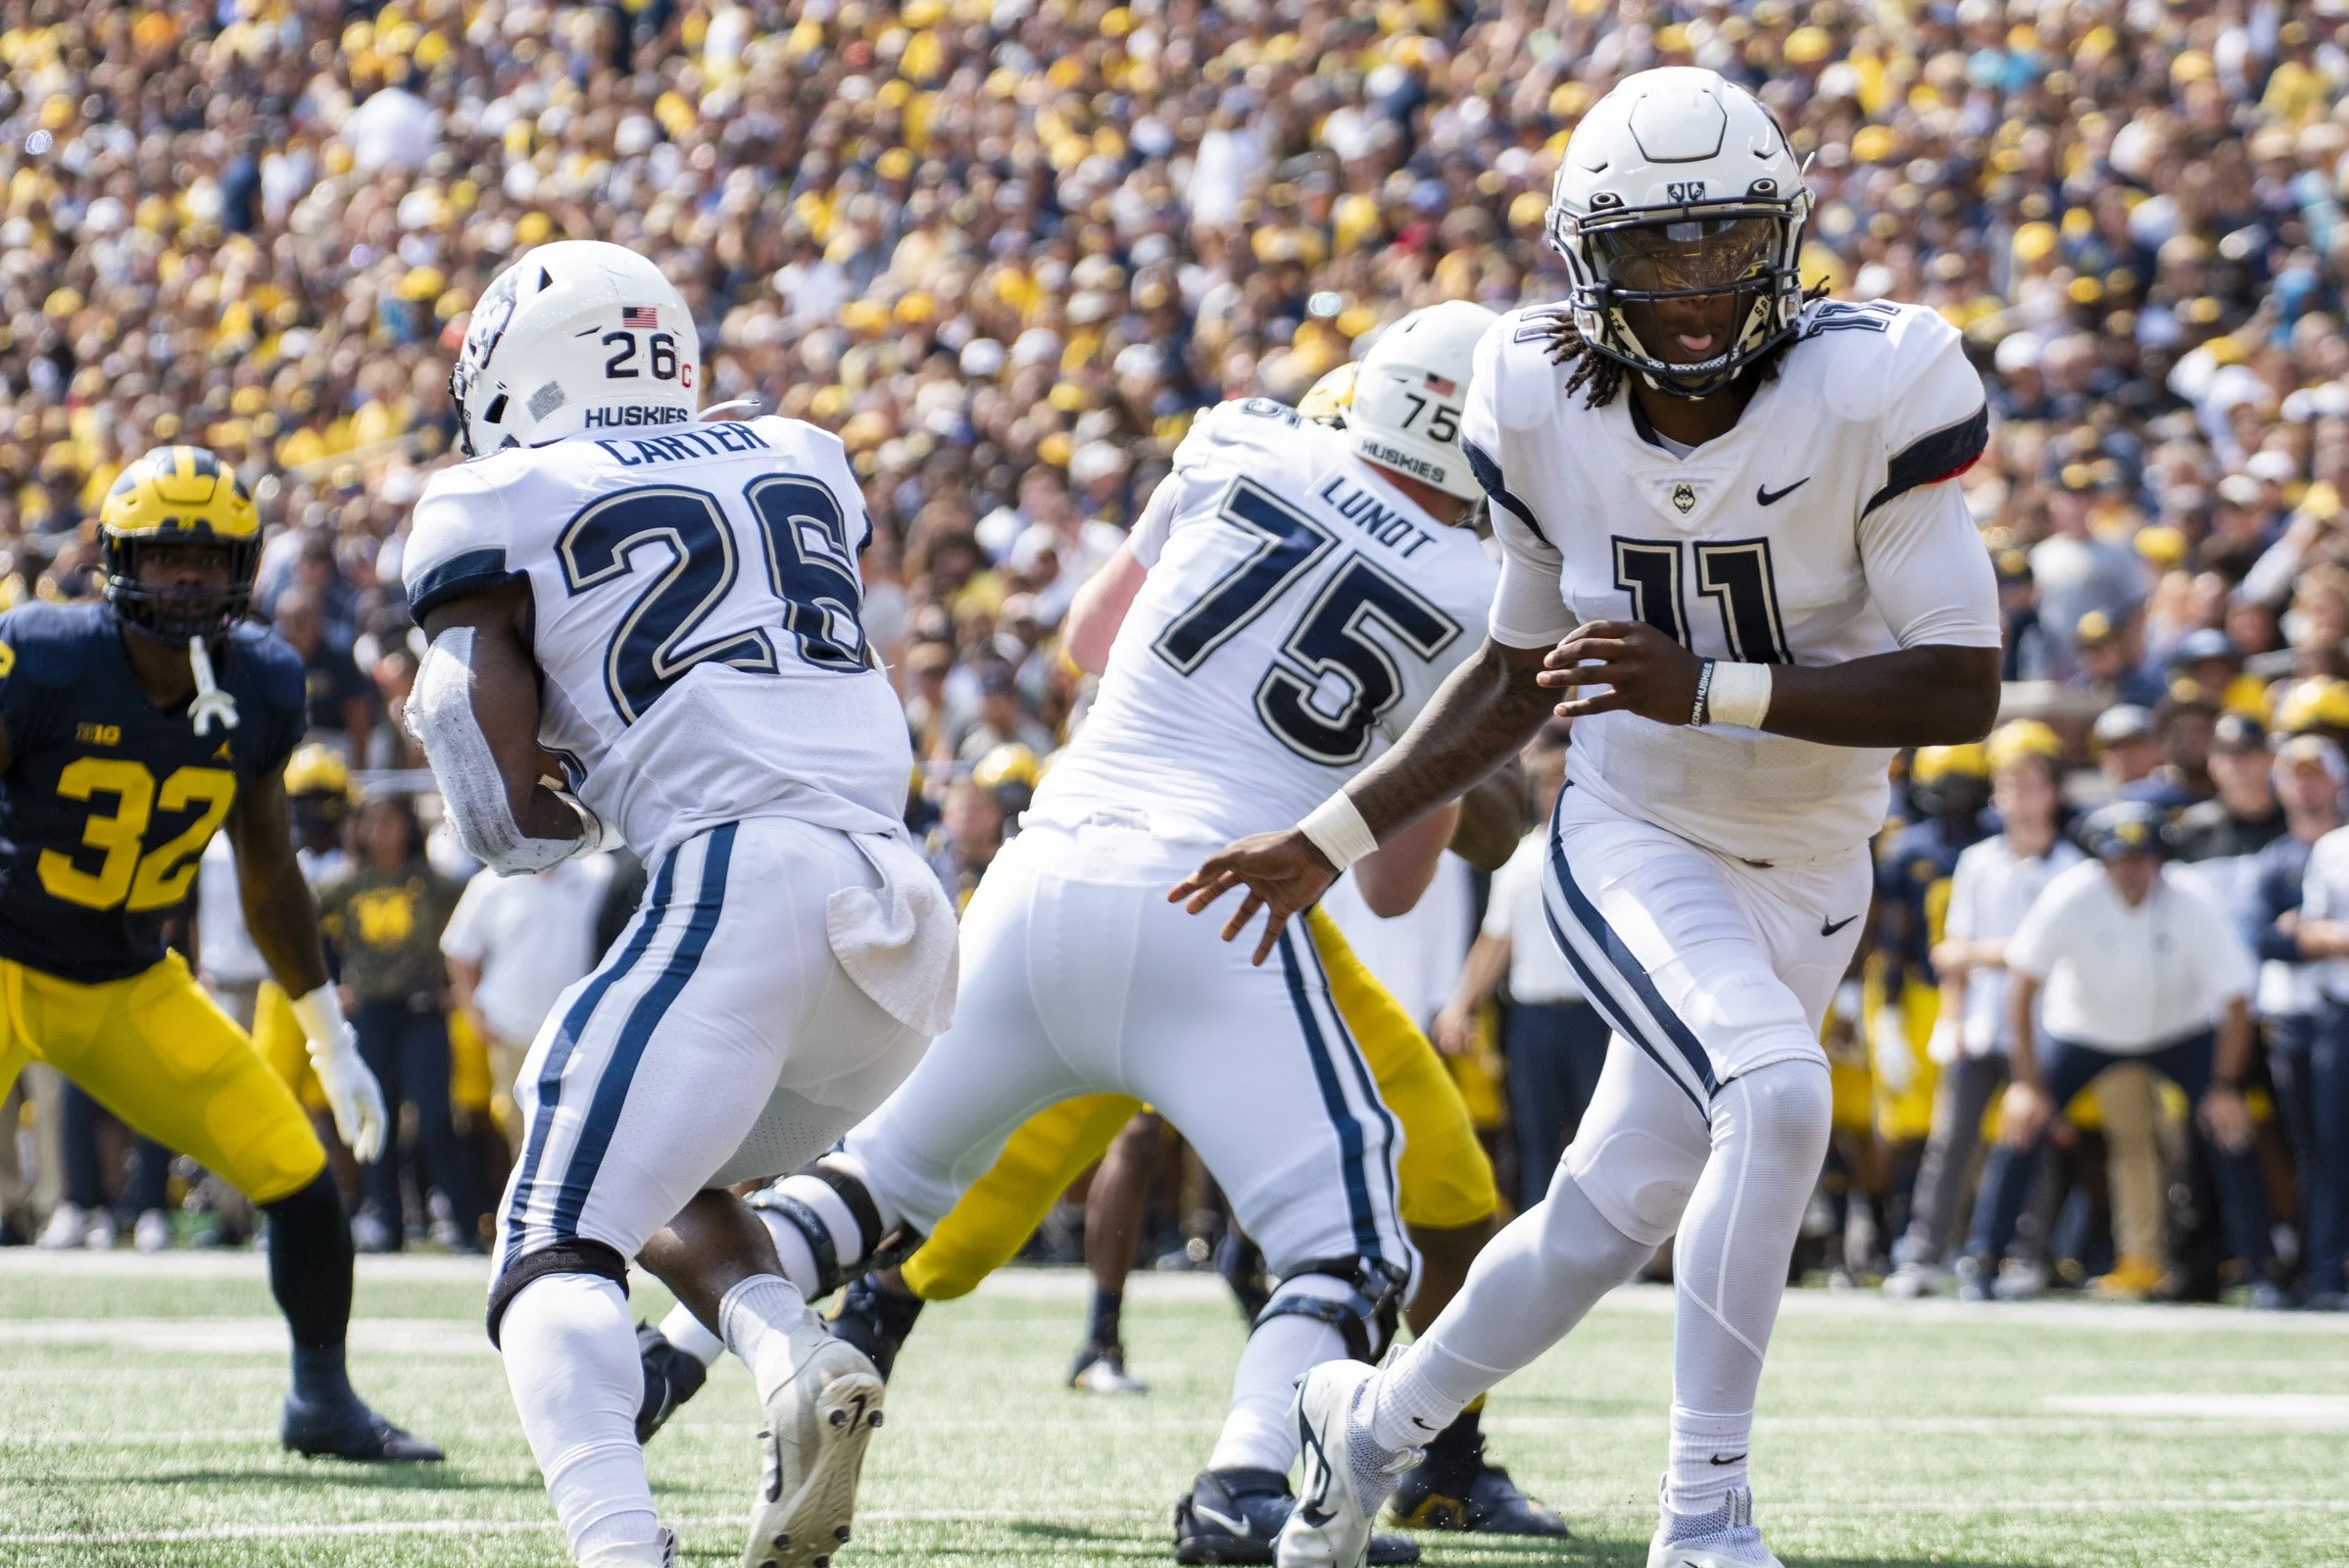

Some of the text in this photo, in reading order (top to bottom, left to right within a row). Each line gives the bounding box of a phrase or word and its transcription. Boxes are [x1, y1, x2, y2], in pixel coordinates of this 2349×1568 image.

[601, 330, 677, 380] 26
[680, 363, 692, 388] C
[584, 405, 688, 428] HUSKIES
[1399, 392, 1461, 442] 75
[594, 422, 770, 466] CARTER
[1361, 439, 1446, 483] HUSKIES
[555, 472, 868, 726] 26
[1150, 474, 1464, 767] 75
[1611, 534, 1794, 664] 11
[1691, 662, 1713, 726] CONN HUSKIES
[37, 756, 238, 911] 32
